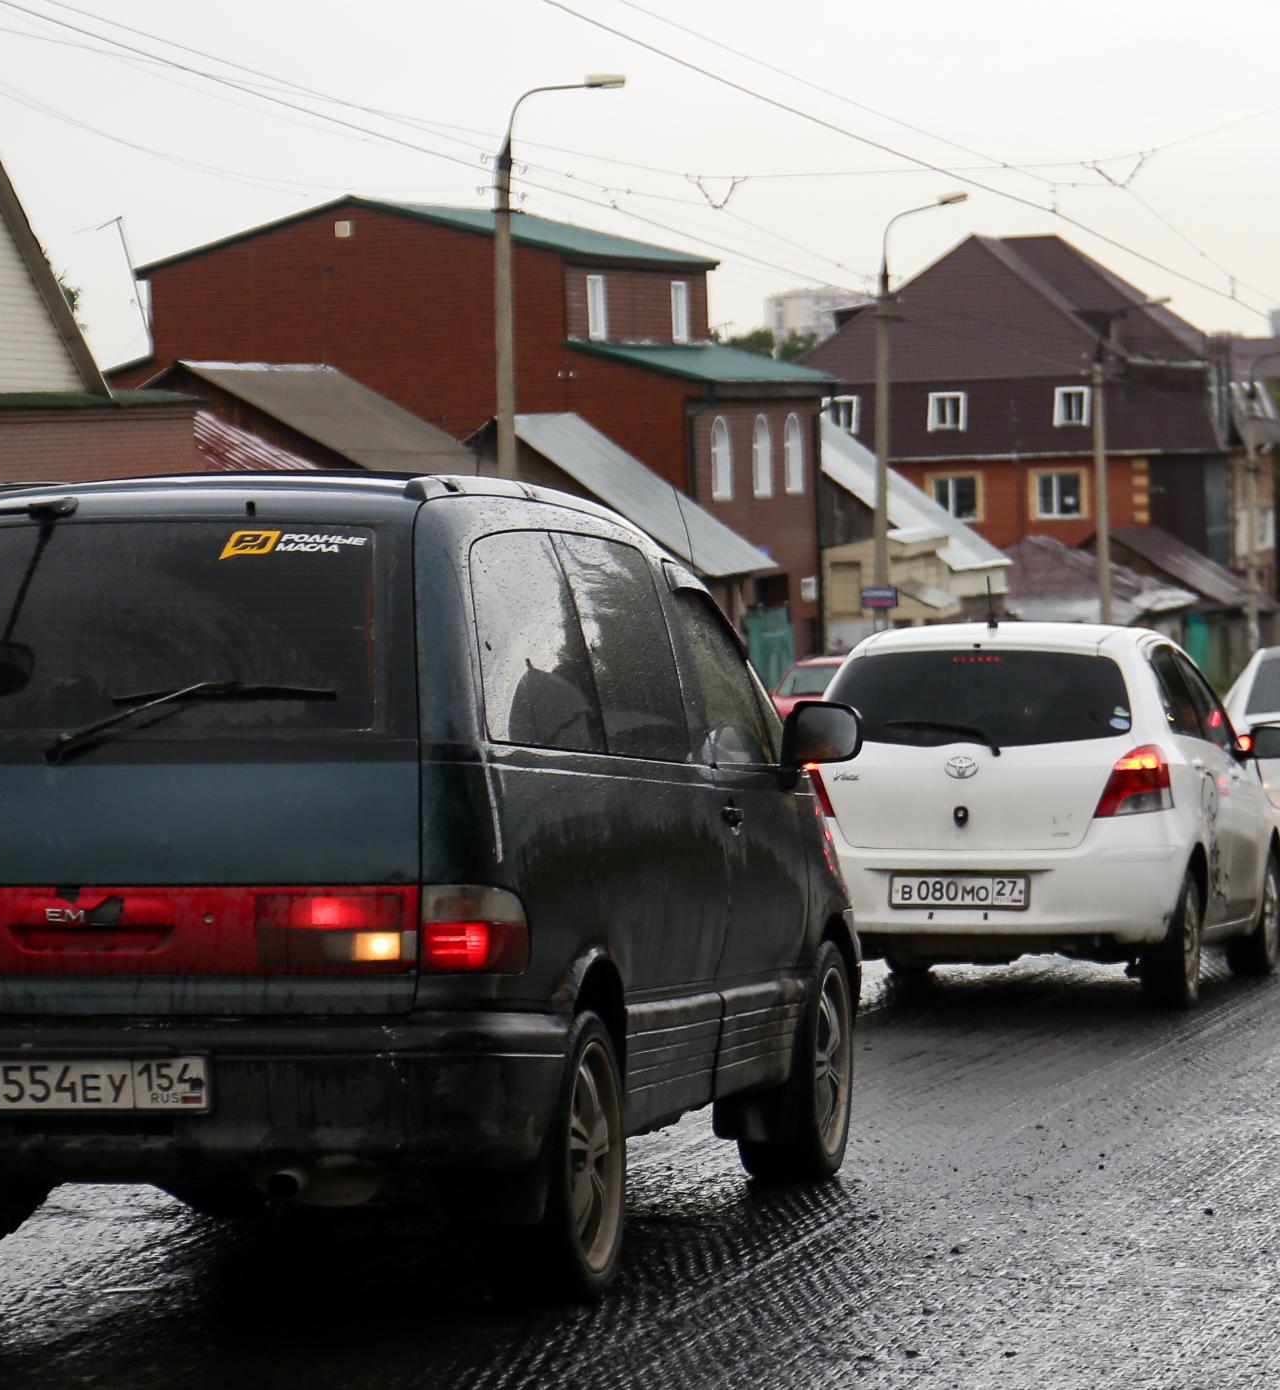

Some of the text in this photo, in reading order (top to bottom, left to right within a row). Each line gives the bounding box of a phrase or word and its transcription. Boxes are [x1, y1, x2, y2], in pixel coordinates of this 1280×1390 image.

[280, 533, 368, 546] РОДНЫЕ
[275, 543, 340, 553] МАСЛА
[995, 880, 1018, 897] 27
[136, 1062, 200, 1092] 154
[150, 1092, 180, 1104] RUS
